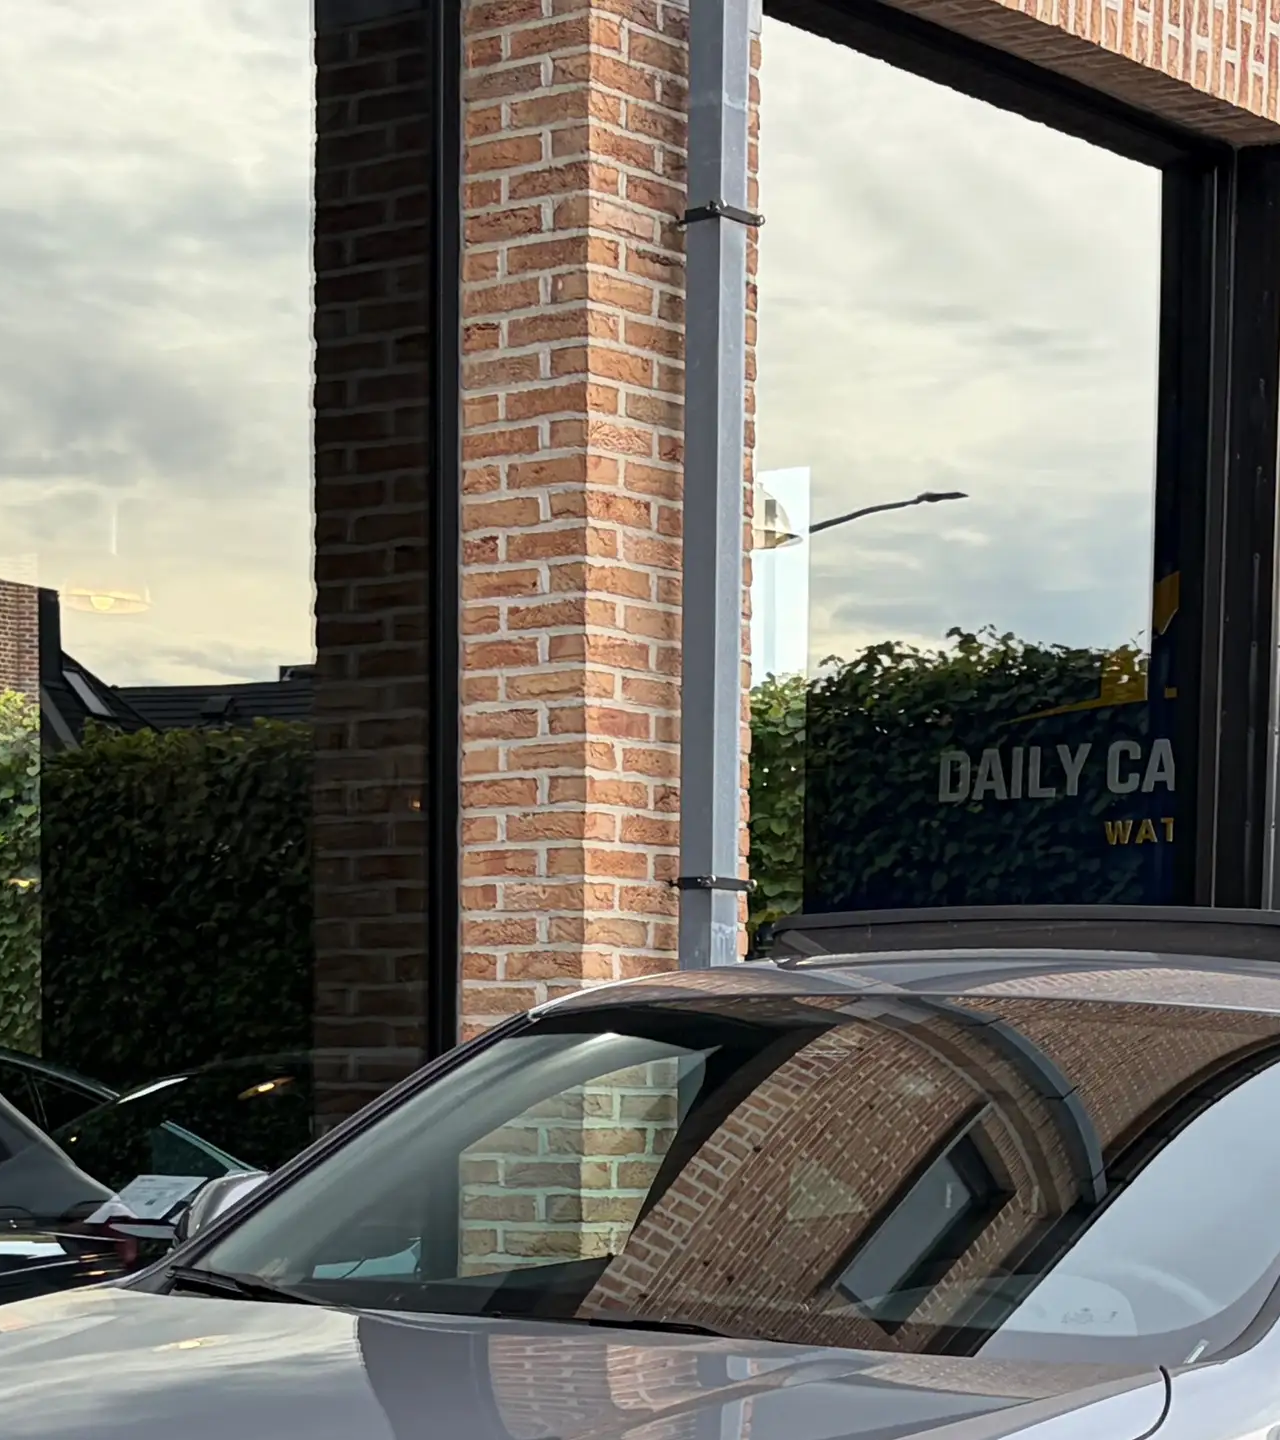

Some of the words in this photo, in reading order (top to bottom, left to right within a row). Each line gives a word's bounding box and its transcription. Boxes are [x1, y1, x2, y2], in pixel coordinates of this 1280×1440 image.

[938, 739, 1092, 804] DAILY
[1106, 738, 1176, 794] CA
[1104, 817, 1174, 846] WAT
